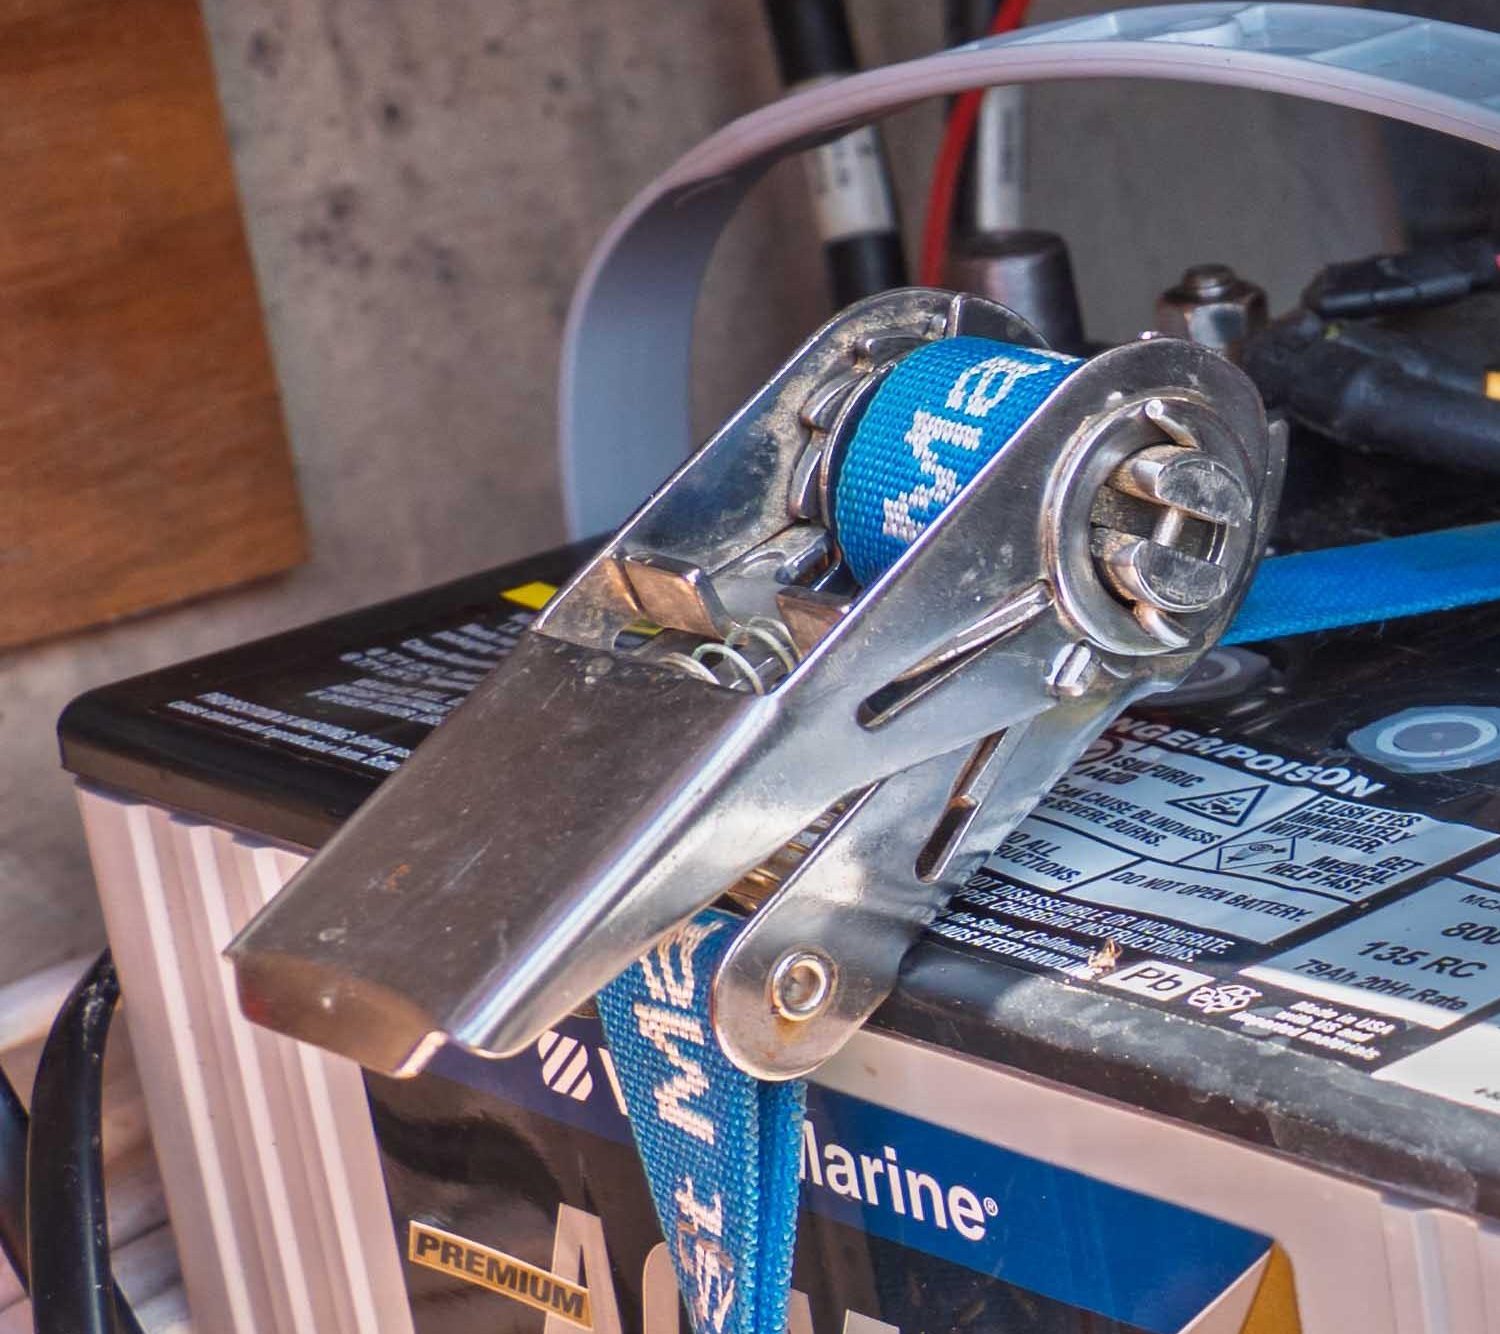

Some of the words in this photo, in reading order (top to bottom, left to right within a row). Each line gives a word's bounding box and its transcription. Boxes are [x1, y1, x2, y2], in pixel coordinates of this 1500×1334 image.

[1114, 718, 1387, 798] NGER/POISON
[1055, 798, 1113, 825] SEVERE
[1082, 790, 1138, 815] CAUSE
[1129, 808, 1223, 846] BLINDNESS
[1307, 798, 1375, 820] FLUSH
[1262, 821, 1321, 839] WITH
[1284, 810, 1417, 845] IMMEDIATELY
[1022, 838, 1062, 858] ALL
[1262, 862, 1323, 882] HELP
[1306, 855, 1398, 885] MEDICAL
[1374, 855, 1425, 873] GET
[992, 884, 1112, 921] DISASSEMBLE
[1103, 911, 1132, 927] OR
[1109, 871, 1148, 885] DO
[1138, 876, 1187, 893] NOT
[1175, 884, 1229, 902] OPEN
[1222, 891, 1314, 923] BATTERY.
[1358, 940, 1432, 967] 135
[1427, 954, 1489, 979] RC
[1120, 966, 1187, 993] Pb
[1295, 958, 1362, 983] 79Ah
[1351, 973, 1418, 998] 20Hr
[1412, 988, 1471, 1012] Rate
[1311, 1019, 1341, 1033] US
[1355, 1017, 1397, 1036] USA
[414, 1229, 585, 1320] PREMIUM
